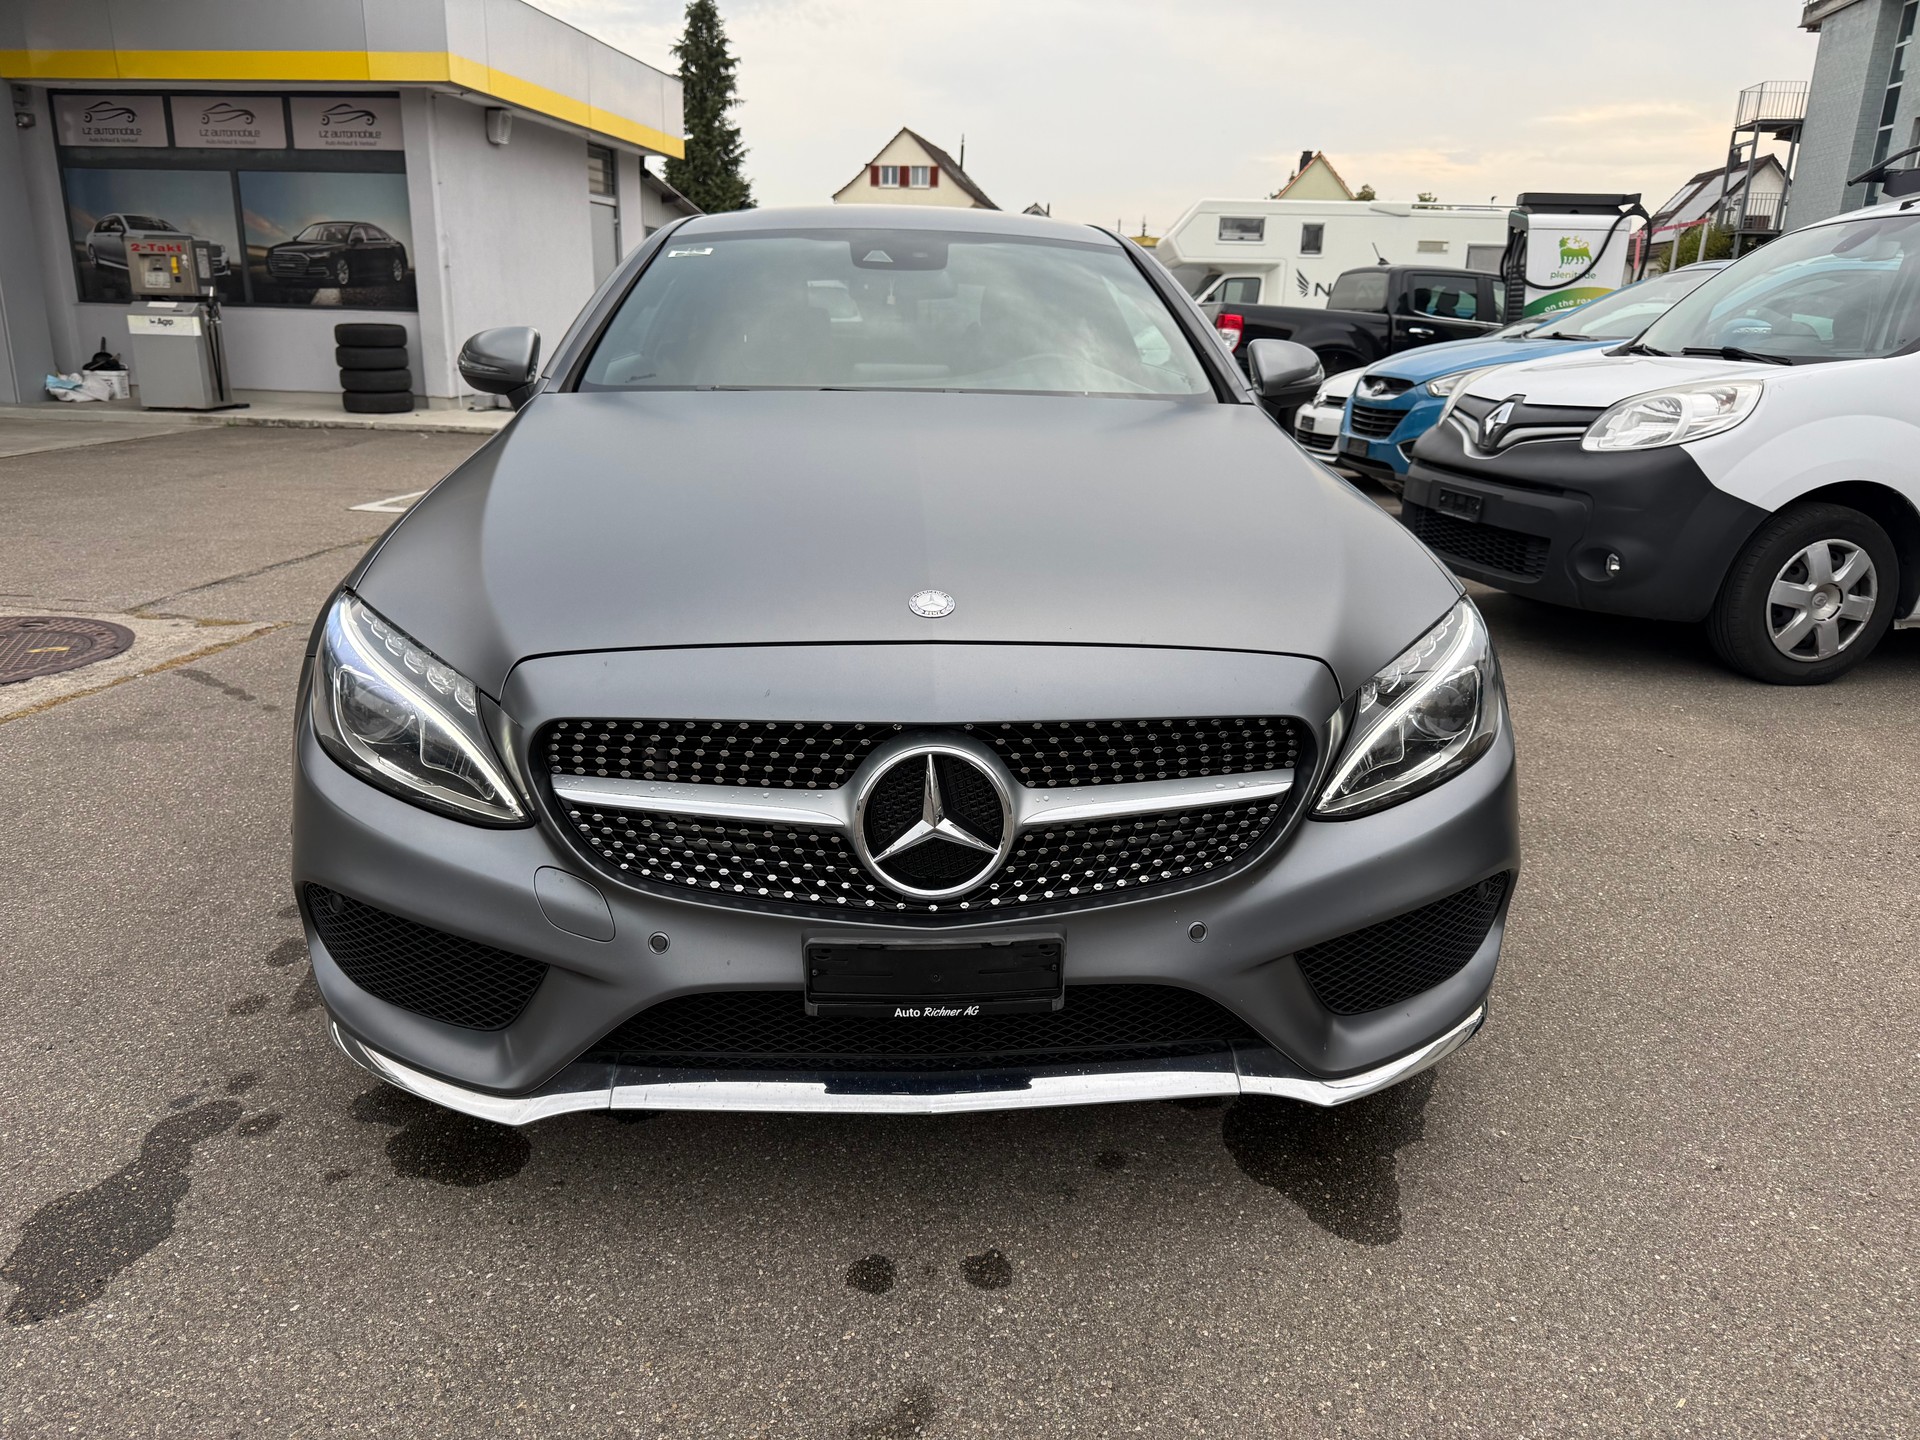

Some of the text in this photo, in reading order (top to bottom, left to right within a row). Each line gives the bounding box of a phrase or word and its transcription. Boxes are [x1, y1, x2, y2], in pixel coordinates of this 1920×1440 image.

[130, 243, 182, 252] 2-Takt
[1550, 271, 1596, 279] plenitde
[1544, 304, 1557, 313] on
[1558, 299, 1574, 308] the
[894, 1005, 979, 1017] Auto Richner AG
